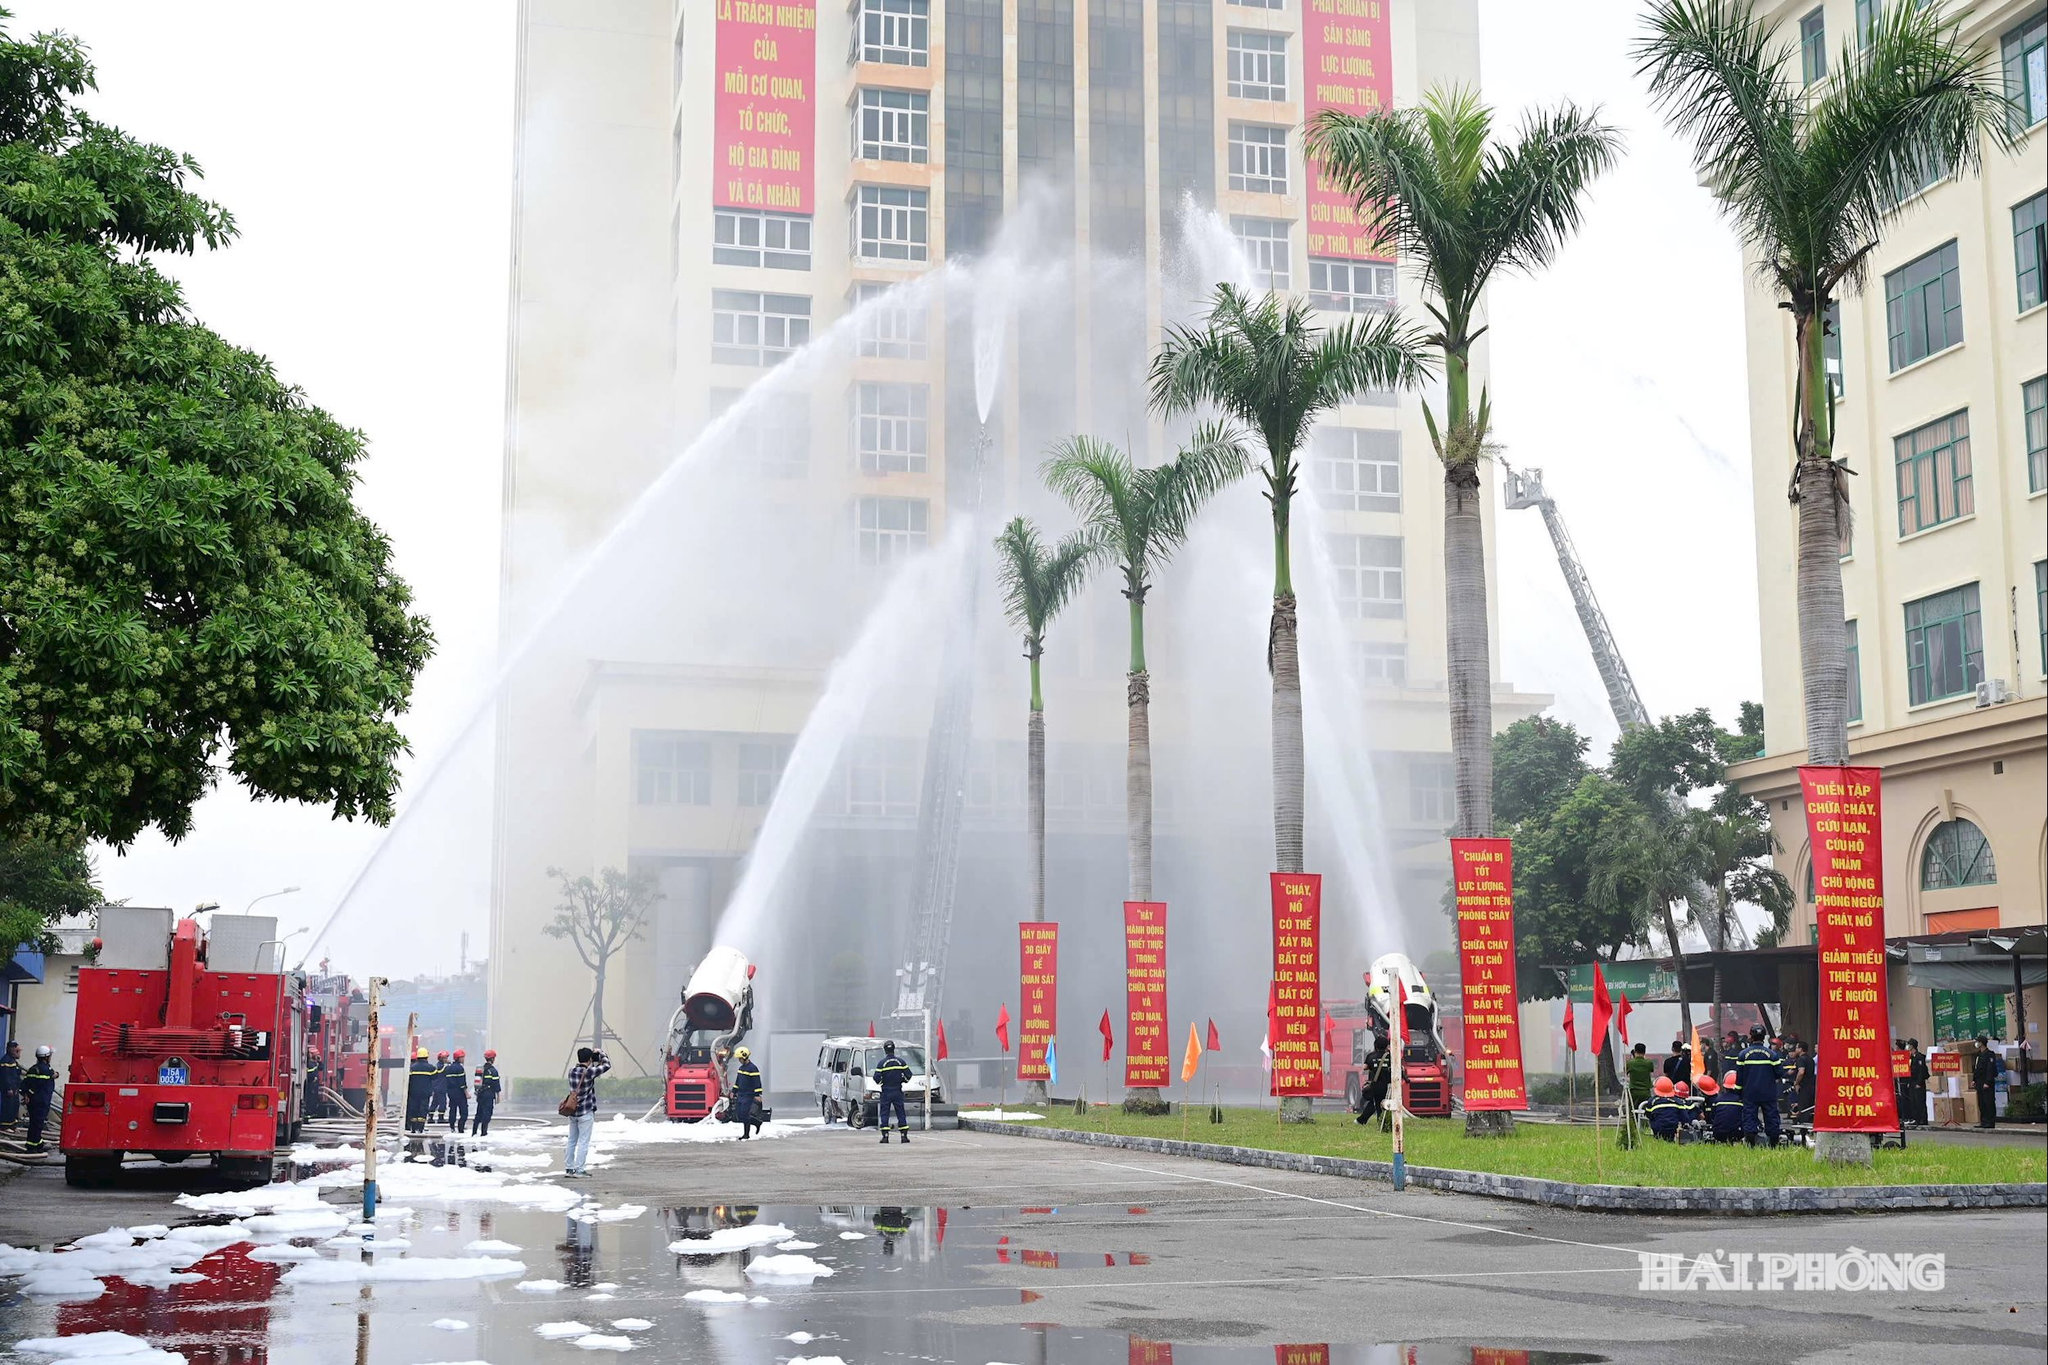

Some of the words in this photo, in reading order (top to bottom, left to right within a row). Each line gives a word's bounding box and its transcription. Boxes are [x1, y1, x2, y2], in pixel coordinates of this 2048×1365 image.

[735, 0, 773, 26] TRÁCH
[777, 4, 815, 32] NHIỆM
[1371, 2, 1380, 23] BỊ
[1324, 20, 1343, 44] SẴN
[1346, 24, 1371, 48] SÀNG
[754, 33, 778, 61] CỦA
[1322, 55, 1339, 76] LỰC
[1342, 57, 1375, 80] LƯỢNG,
[725, 66, 747, 94] MỖI
[751, 73, 767, 96] CƠ
[771, 76, 806, 103] QUAN,
[1317, 84, 1355, 102] PHƯƠNG
[739, 102, 754, 131] TỔ
[756, 108, 792, 138] CHỨC,
[729, 142, 744, 171] HỘ
[749, 147, 768, 168] GIA
[772, 146, 800, 172] ĐÌNH
[728, 178, 744, 202] VÀ
[748, 179, 764, 204] CÁ
[767, 182, 800, 207] NHÂN
[1311, 200, 1330, 222] CỨU
[1333, 206, 1356, 228] NẠN,
[1308, 234, 1324, 255] KỊP
[1327, 232, 1351, 255] THỜI,
[1847, 783, 1871, 799] TẬP
[1808, 801, 1840, 814] CHỮA
[1843, 802, 1876, 816] CHÁY,
[1816, 819, 1840, 832] CỨU
[1843, 822, 1870, 835] NẠN,
[1826, 838, 1847, 852] CỨU
[1848, 838, 1864, 855] HỘ
[1494, 852, 1503, 864] BỊ
[1832, 854, 1861, 870] NHẰM
[1474, 864, 1490, 876] TỐT
[1458, 881, 1474, 893] LỰC
[1477, 881, 1506, 893] LƯỢNG,
[1822, 873, 1842, 888] CHỦ
[1846, 876, 1875, 892] ĐỘNG
[1289, 898, 1302, 912] NỔ
[1456, 896, 1490, 906] PHƯƠNG
[1492, 896, 1510, 908] TIỆN
[1816, 894, 1852, 908] PHÒNG
[1852, 895, 1884, 908] NGỪA
[1458, 910, 1487, 920] PHÒNG
[1488, 910, 1510, 920] CHÁY
[1828, 912, 1853, 928] CHÁY,
[1856, 911, 1873, 927] NỔ
[1127, 924, 1144, 934] HÀNH
[1146, 924, 1164, 936] ĐỘNG
[1279, 918, 1292, 930] CÓ
[1295, 916, 1312, 930] THỂ
[1480, 924, 1490, 935] VÀ
[1022, 929, 1034, 940] HÃY
[1279, 933, 1298, 947] XẢY
[1300, 936, 1312, 948] RA
[1844, 932, 1856, 945] VÀ
[1025, 945, 1034, 954] 30
[1036, 943, 1051, 954] GIÂY
[1128, 938, 1145, 949] THIẾT
[1147, 940, 1164, 952] THỰC
[1462, 939, 1485, 950] CHỮA
[1487, 938, 1508, 950] CHÁY
[1034, 957, 1042, 969] ĐỂ
[1136, 954, 1156, 964] TRONG
[1278, 950, 1297, 964] BẤT
[1300, 952, 1313, 964] CỨ
[1470, 956, 1484, 967] TẠI
[1823, 948, 1850, 964] GIẢM
[1852, 950, 1883, 964] THIỂU
[1022, 975, 1039, 986] QUAN
[1041, 973, 1054, 984] SÁT
[1274, 969, 1293, 982] LÚC
[1296, 970, 1317, 984] NÀO,
[1482, 968, 1492, 980] LÀ
[1829, 970, 1856, 986] THIỆT
[1858, 972, 1877, 987] HẠI
[1032, 987, 1043, 999] LỐI
[1148, 982, 1164, 992] CHÁY
[1278, 985, 1297, 1000] BẤT
[1300, 987, 1313, 1000] CỨ
[1464, 983, 1488, 994] THIẾT
[1490, 985, 1512, 997] THỰC
[1142, 996, 1151, 1006] VÀ
[1829, 987, 1842, 1002] VỀ
[1846, 990, 1877, 1002] NGƯỜI
[1033, 1003, 1042, 1014] VÀ
[1277, 1006, 1294, 1016] NƠI
[1296, 1004, 1316, 1017] ĐÂU
[1474, 998, 1492, 1010] BẢO
[1494, 998, 1504, 1011] VỆ
[1131, 1010, 1144, 1021] CỨU
[1146, 1011, 1162, 1023] NẠN,
[1464, 1014, 1484, 1024] TÍNH
[1486, 1014, 1514, 1026] MẠNG,
[1847, 1007, 1859, 1021] VÀ
[1026, 1017, 1049, 1030] ĐƯỜNG
[1134, 1024, 1148, 1036] CỨU
[1150, 1025, 1160, 1037] HỘ
[1286, 1020, 1306, 1034] NẾU
[1474, 1028, 1487, 1039] TÀI
[1490, 1026, 1507, 1039] SẢN
[1832, 1026, 1850, 1040] TÀI
[1854, 1026, 1876, 1040] SẢN
[1274, 1040, 1306, 1052] CHÚNG
[1309, 1042, 1320, 1052] TA
[1482, 1041, 1500, 1054] CỦA
[1030, 1049, 1043, 1059] NƠI
[1127, 1054, 1153, 1064] TRƯỜNG
[1154, 1056, 1168, 1066] HỌC
[1848, 1048, 1860, 1059] DO
[1022, 1064, 1036, 1076] BẠN
[1272, 1056, 1291, 1070] CHỦ
[1294, 1059, 1322, 1070] QUAN,
[1466, 1058, 1492, 1069] CHÍNH
[1495, 1058, 1518, 1068] MÌNH
[1130, 1070, 1140, 1080] AN
[1487, 1072, 1498, 1084] VÀ
[1831, 1066, 1848, 1078] TAI
[1852, 1067, 1880, 1081] NẠN,
[1280, 1076, 1292, 1088] LƠ
[1465, 1087, 1489, 1101] CỘNG
[1838, 1085, 1854, 1100] SỰ
[1856, 1082, 1872, 1098] CỐ
[1828, 1102, 1854, 1117] GÂY
